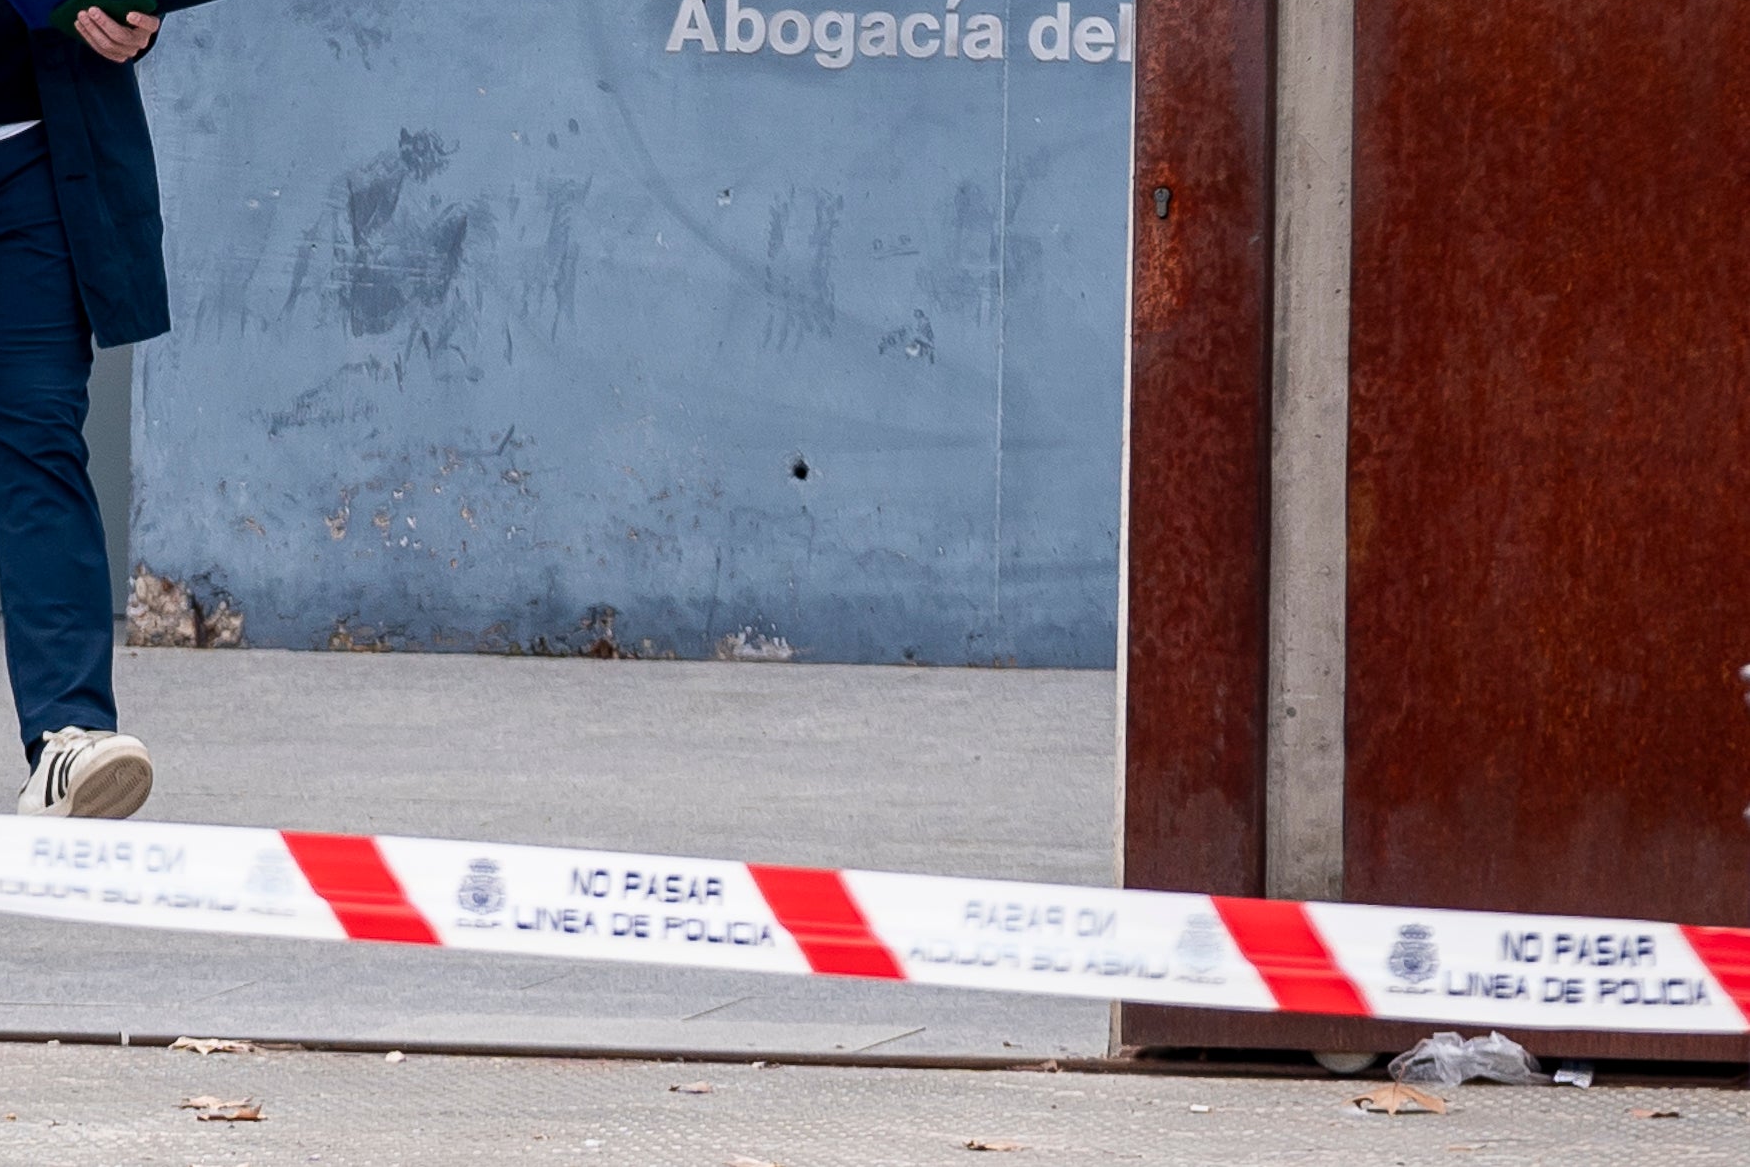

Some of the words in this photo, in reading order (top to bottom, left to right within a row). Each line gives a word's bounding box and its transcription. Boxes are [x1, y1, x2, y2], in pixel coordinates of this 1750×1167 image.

[1028, 2, 1132, 63] del
[572, 867, 611, 898] NO
[624, 872, 723, 906] PASAR
[515, 905, 597, 934] LINEA
[612, 912, 650, 938] DE
[665, 917, 775, 947] POLICIA
[1501, 931, 1543, 963] NO
[1554, 934, 1657, 967] PASAR
[1446, 970, 1530, 1000] LINEA
[1541, 976, 1585, 1004] DE
[1599, 977, 1712, 1006] POLICIA
